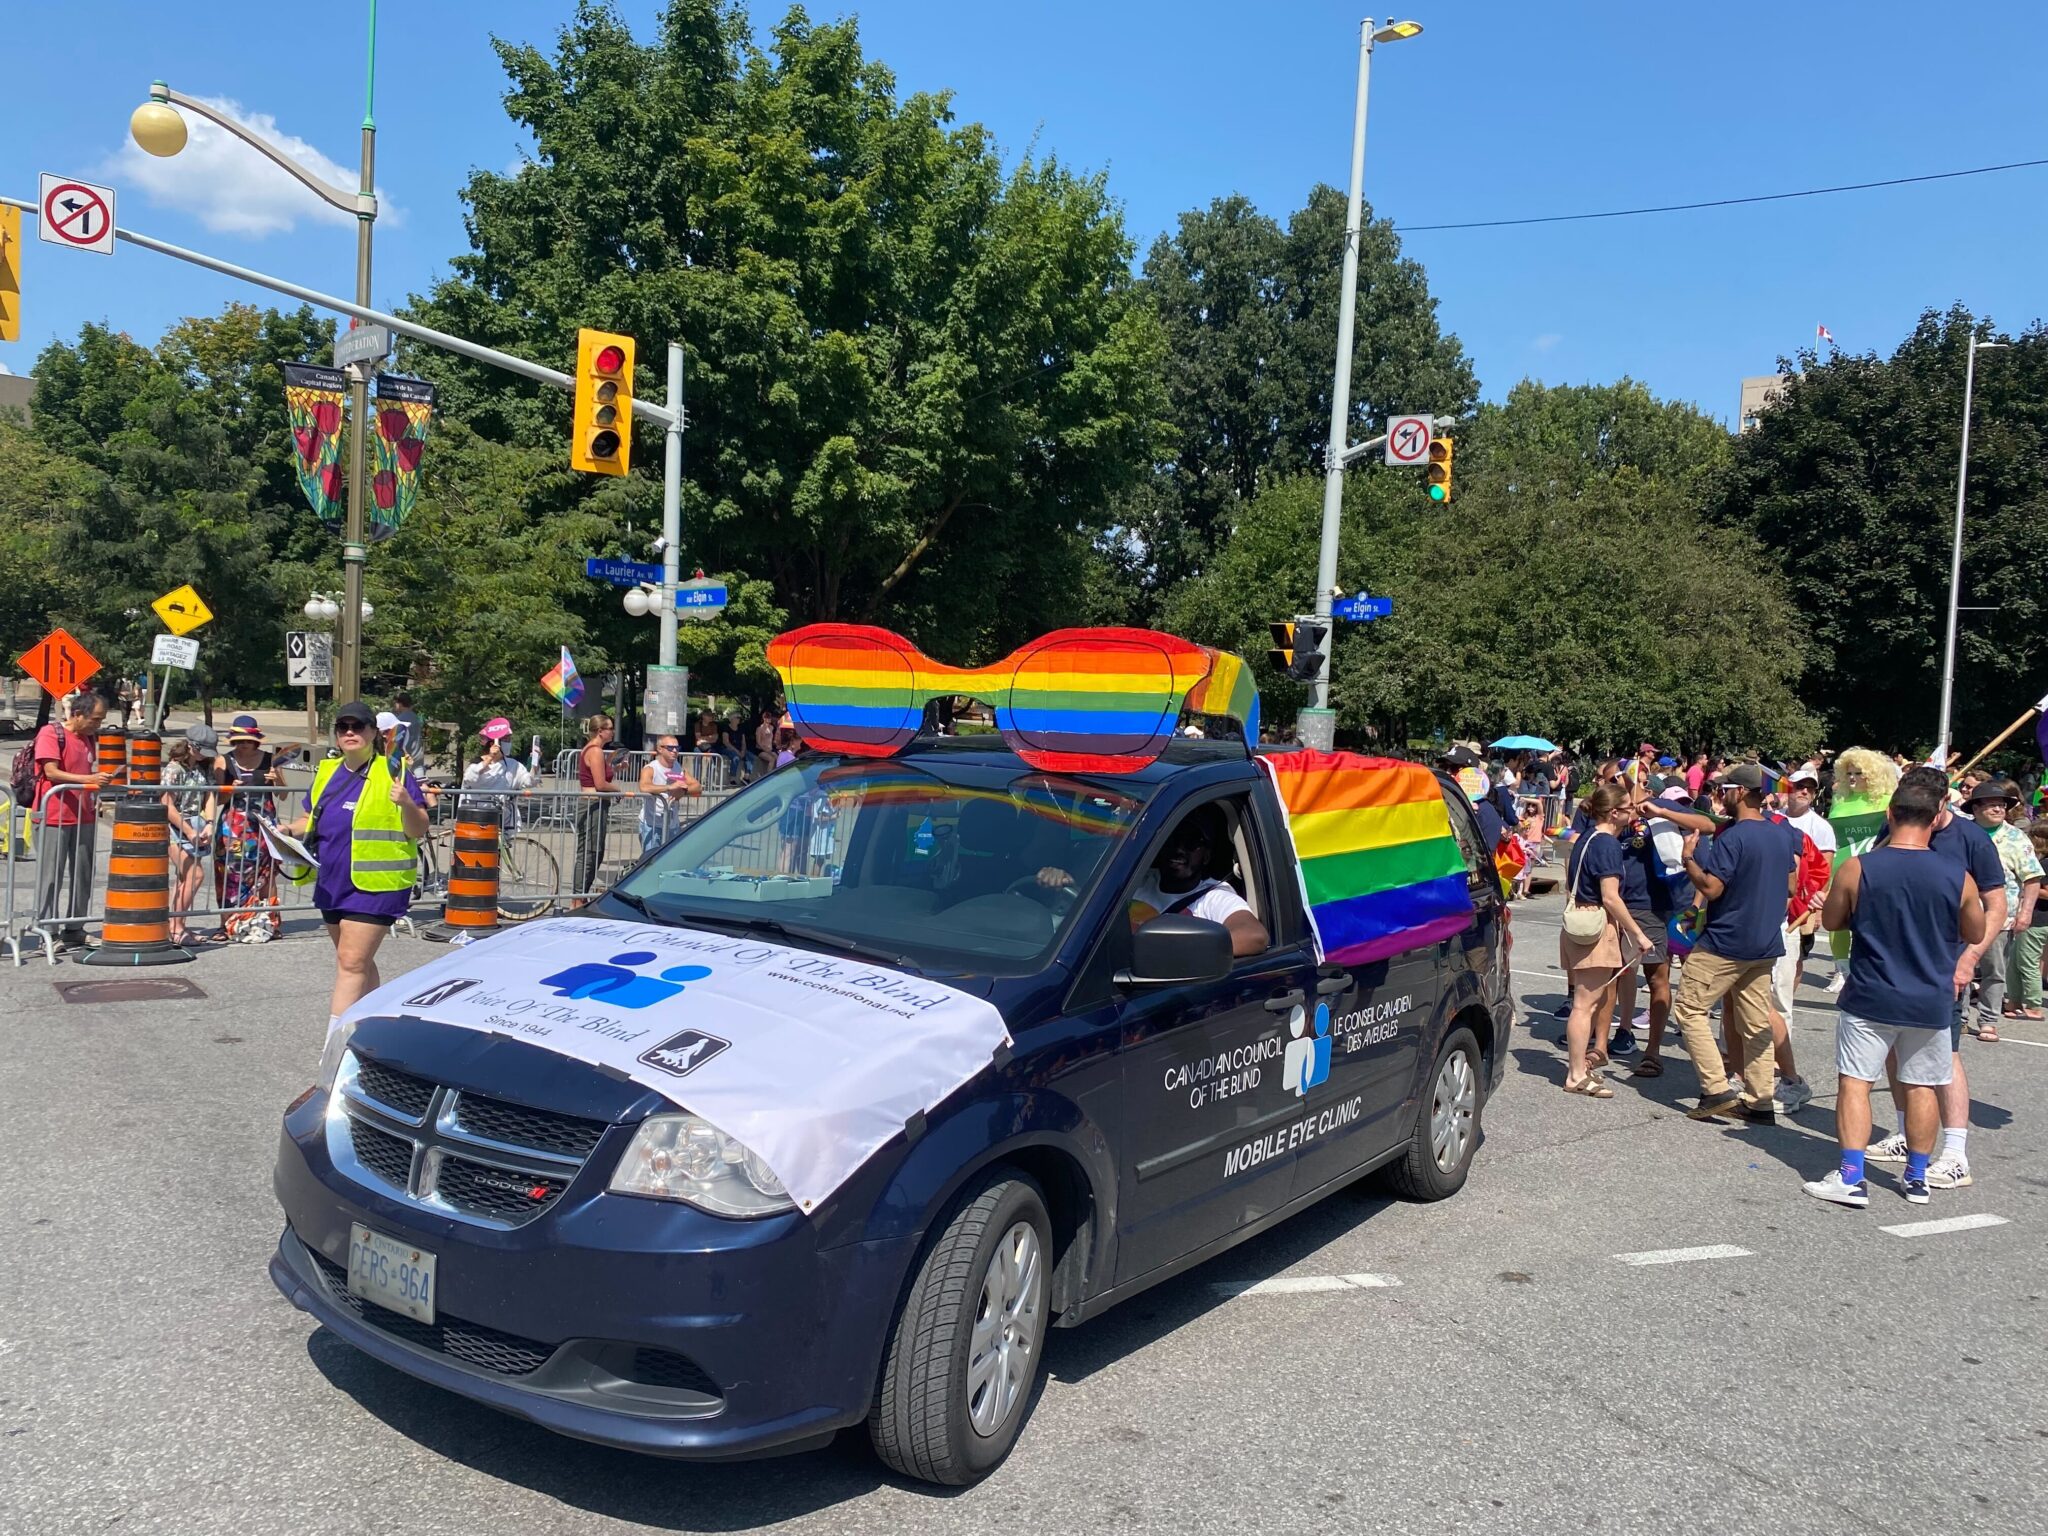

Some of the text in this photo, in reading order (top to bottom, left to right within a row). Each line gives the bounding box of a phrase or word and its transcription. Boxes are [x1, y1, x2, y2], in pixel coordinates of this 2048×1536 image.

[300, 379, 342, 389] Capital Region
[315, 373, 342, 381] Canada's
[605, 563, 635, 577] Laurier
[694, 590, 707, 606] Elgin
[1353, 601, 1371, 615] Elgin
[167, 643, 183, 651] ROAD
[1844, 826, 1872, 835] PARTI
[622, 931, 742, 953] Council
[734, 948, 790, 965] Of
[788, 957, 845, 979] The
[846, 969, 952, 1011] Blind
[767, 971, 916, 1020] www.ccbnational.net
[484, 1015, 553, 1038] Since 1944
[505, 999, 543, 1016] Of
[538, 1005, 580, 1024] The
[578, 1015, 650, 1043] Blind
[1333, 994, 1412, 1037] LE CONSEIL CANADIEN
[1346, 1020, 1398, 1054] DES AVEUGLES
[1164, 1036, 1283, 1091] CANADIAN COUNCIL
[1190, 1068, 1261, 1109] OF THE BLIND
[1223, 1096, 1362, 1178] MOBILE EYE CLINIC
[474, 1176, 533, 1194] DODGE
[374, 1237, 410, 1258] ONTARIO
[350, 1243, 388, 1288] CERS
[399, 1262, 430, 1306] 964
